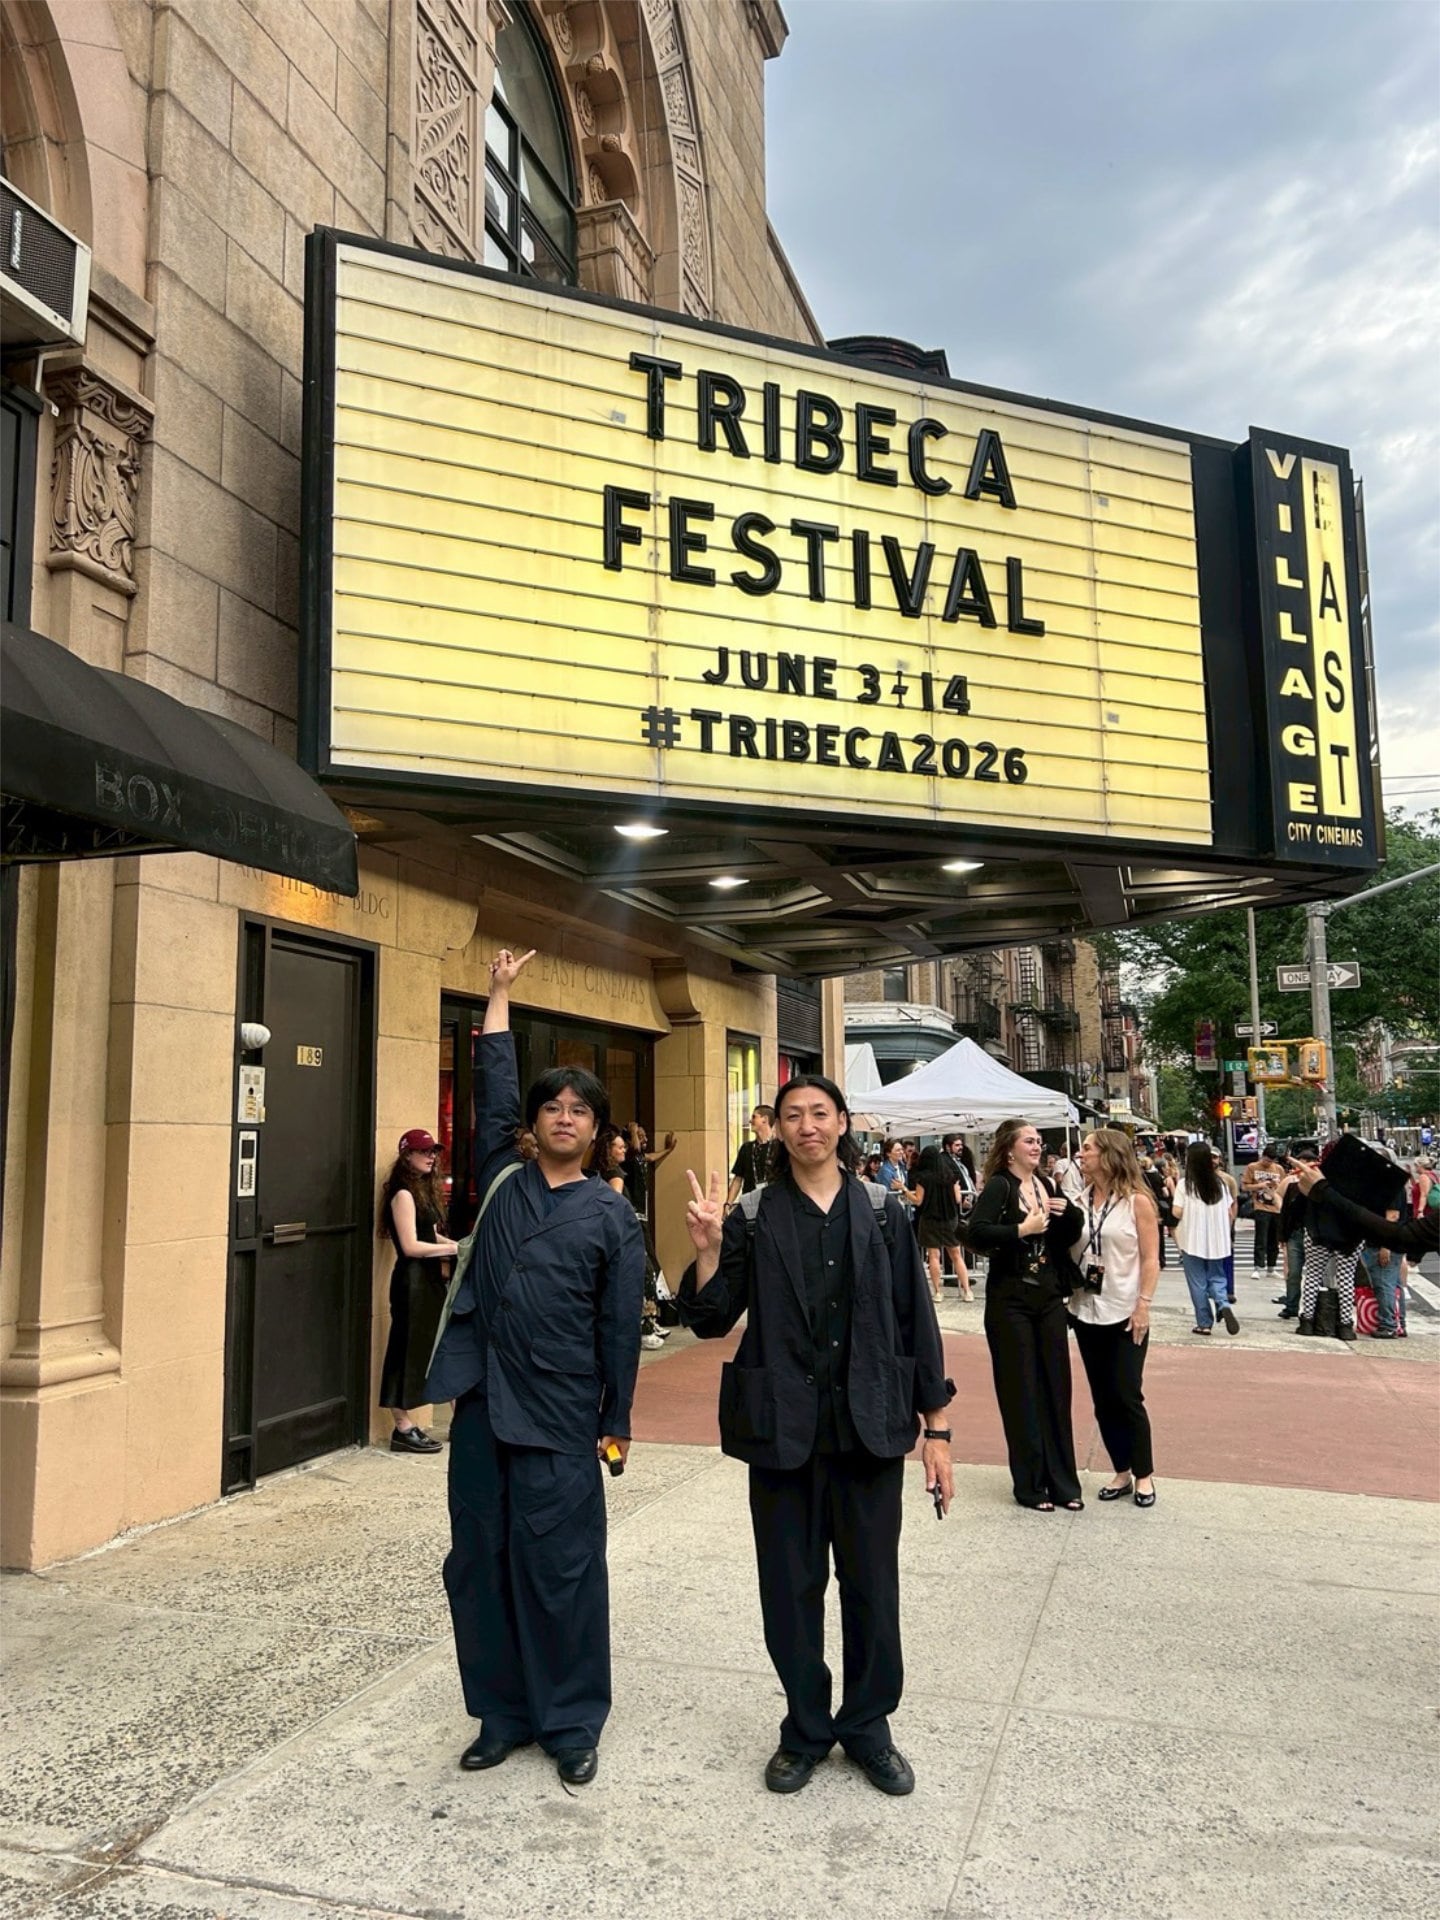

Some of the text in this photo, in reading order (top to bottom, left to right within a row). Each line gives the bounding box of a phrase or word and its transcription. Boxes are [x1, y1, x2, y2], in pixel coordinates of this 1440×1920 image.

[629, 352, 1017, 509] TRIBECA
[603, 484, 1045, 636] FESTIVAL
[1265, 449, 1319, 814] VILLAGE
[702, 646, 837, 700] JUNE
[641, 705, 1028, 785] #TRIBECA2026
[95, 760, 182, 829] BOX
[1288, 820, 1363, 848] CITY CINEMAS
[542, 953, 579, 988] EAST
[584, 964, 646, 1005] CINEMAS
[1287, 970, 1342, 984] ONE AY
[299, 1048, 322, 1066] 189
